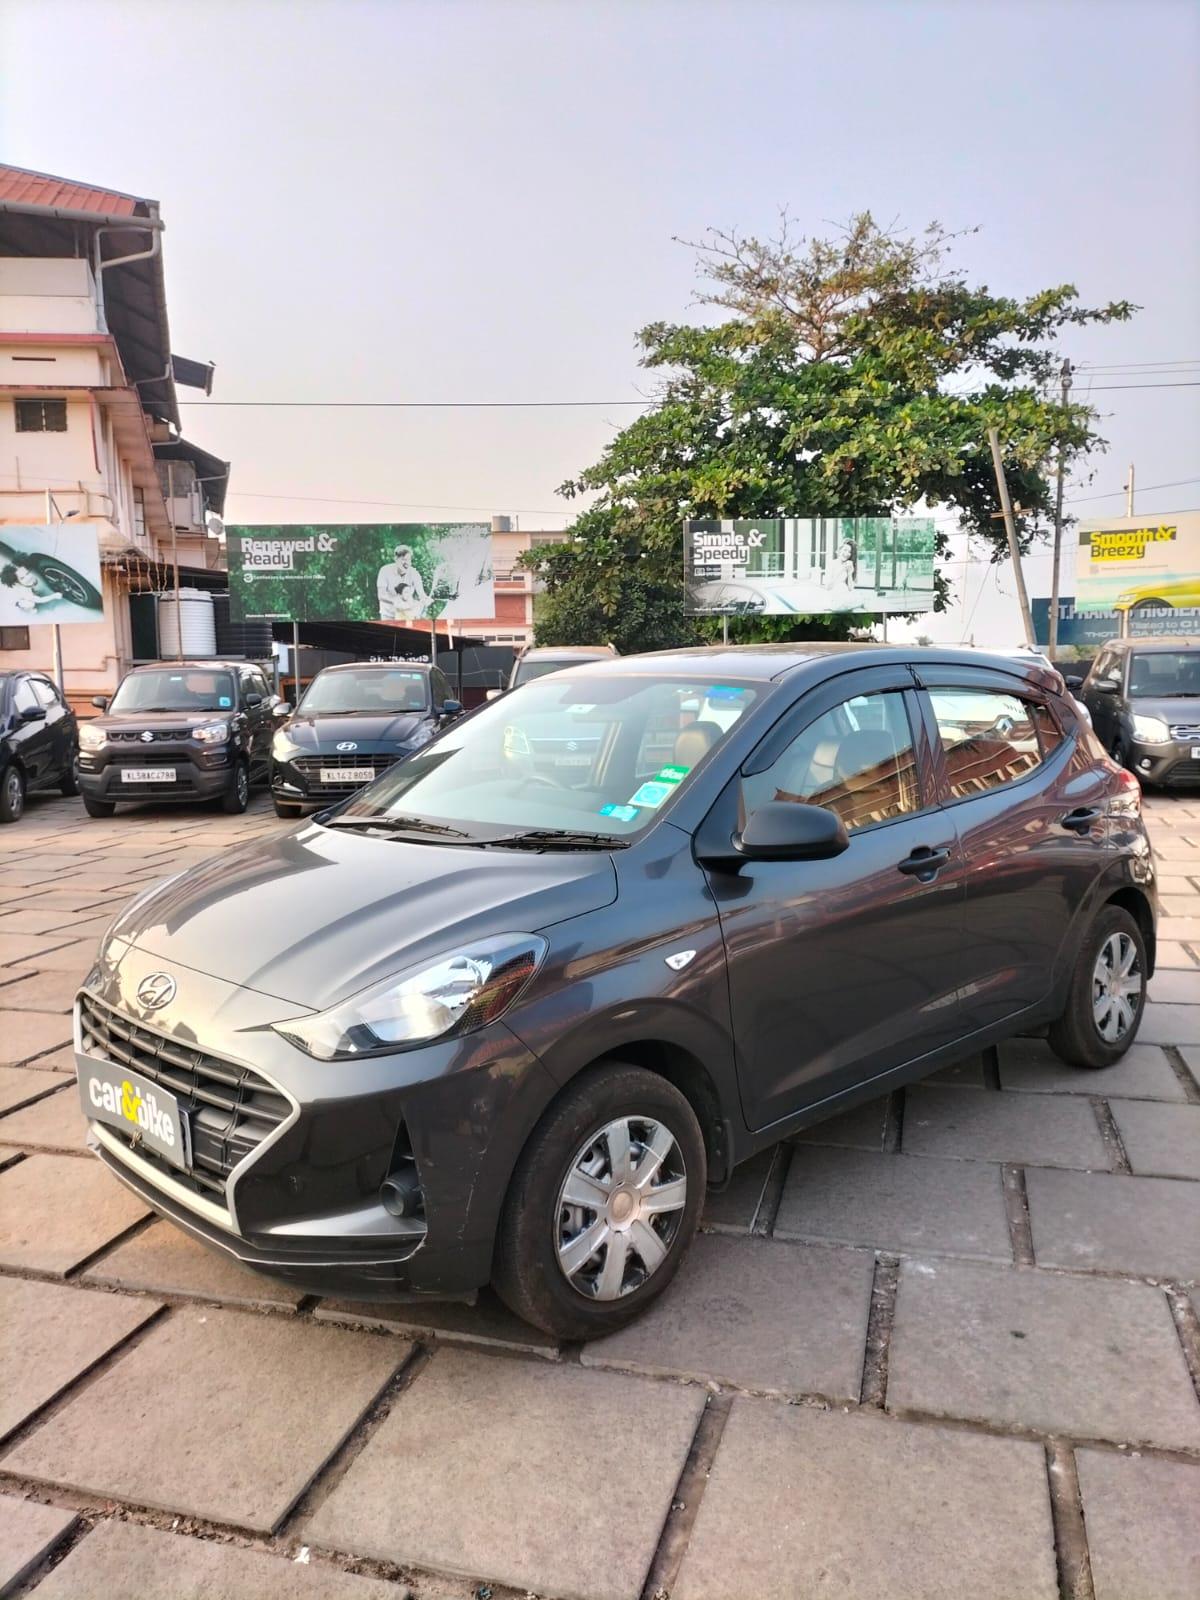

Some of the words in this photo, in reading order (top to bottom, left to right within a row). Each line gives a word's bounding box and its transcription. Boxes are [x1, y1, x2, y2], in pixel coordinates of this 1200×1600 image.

[241, 536, 314, 552] Renewed
[317, 533, 337, 552] &
[693, 531, 744, 547] Simple
[747, 528, 767, 547] &
[1090, 528, 1154, 545] Smooth
[1156, 525, 1176, 541] &
[243, 551, 290, 568] Ready
[693, 547, 748, 563] Speedy
[1091, 544, 1145, 559] Breezy
[89, 1077, 175, 1147] car&bike
